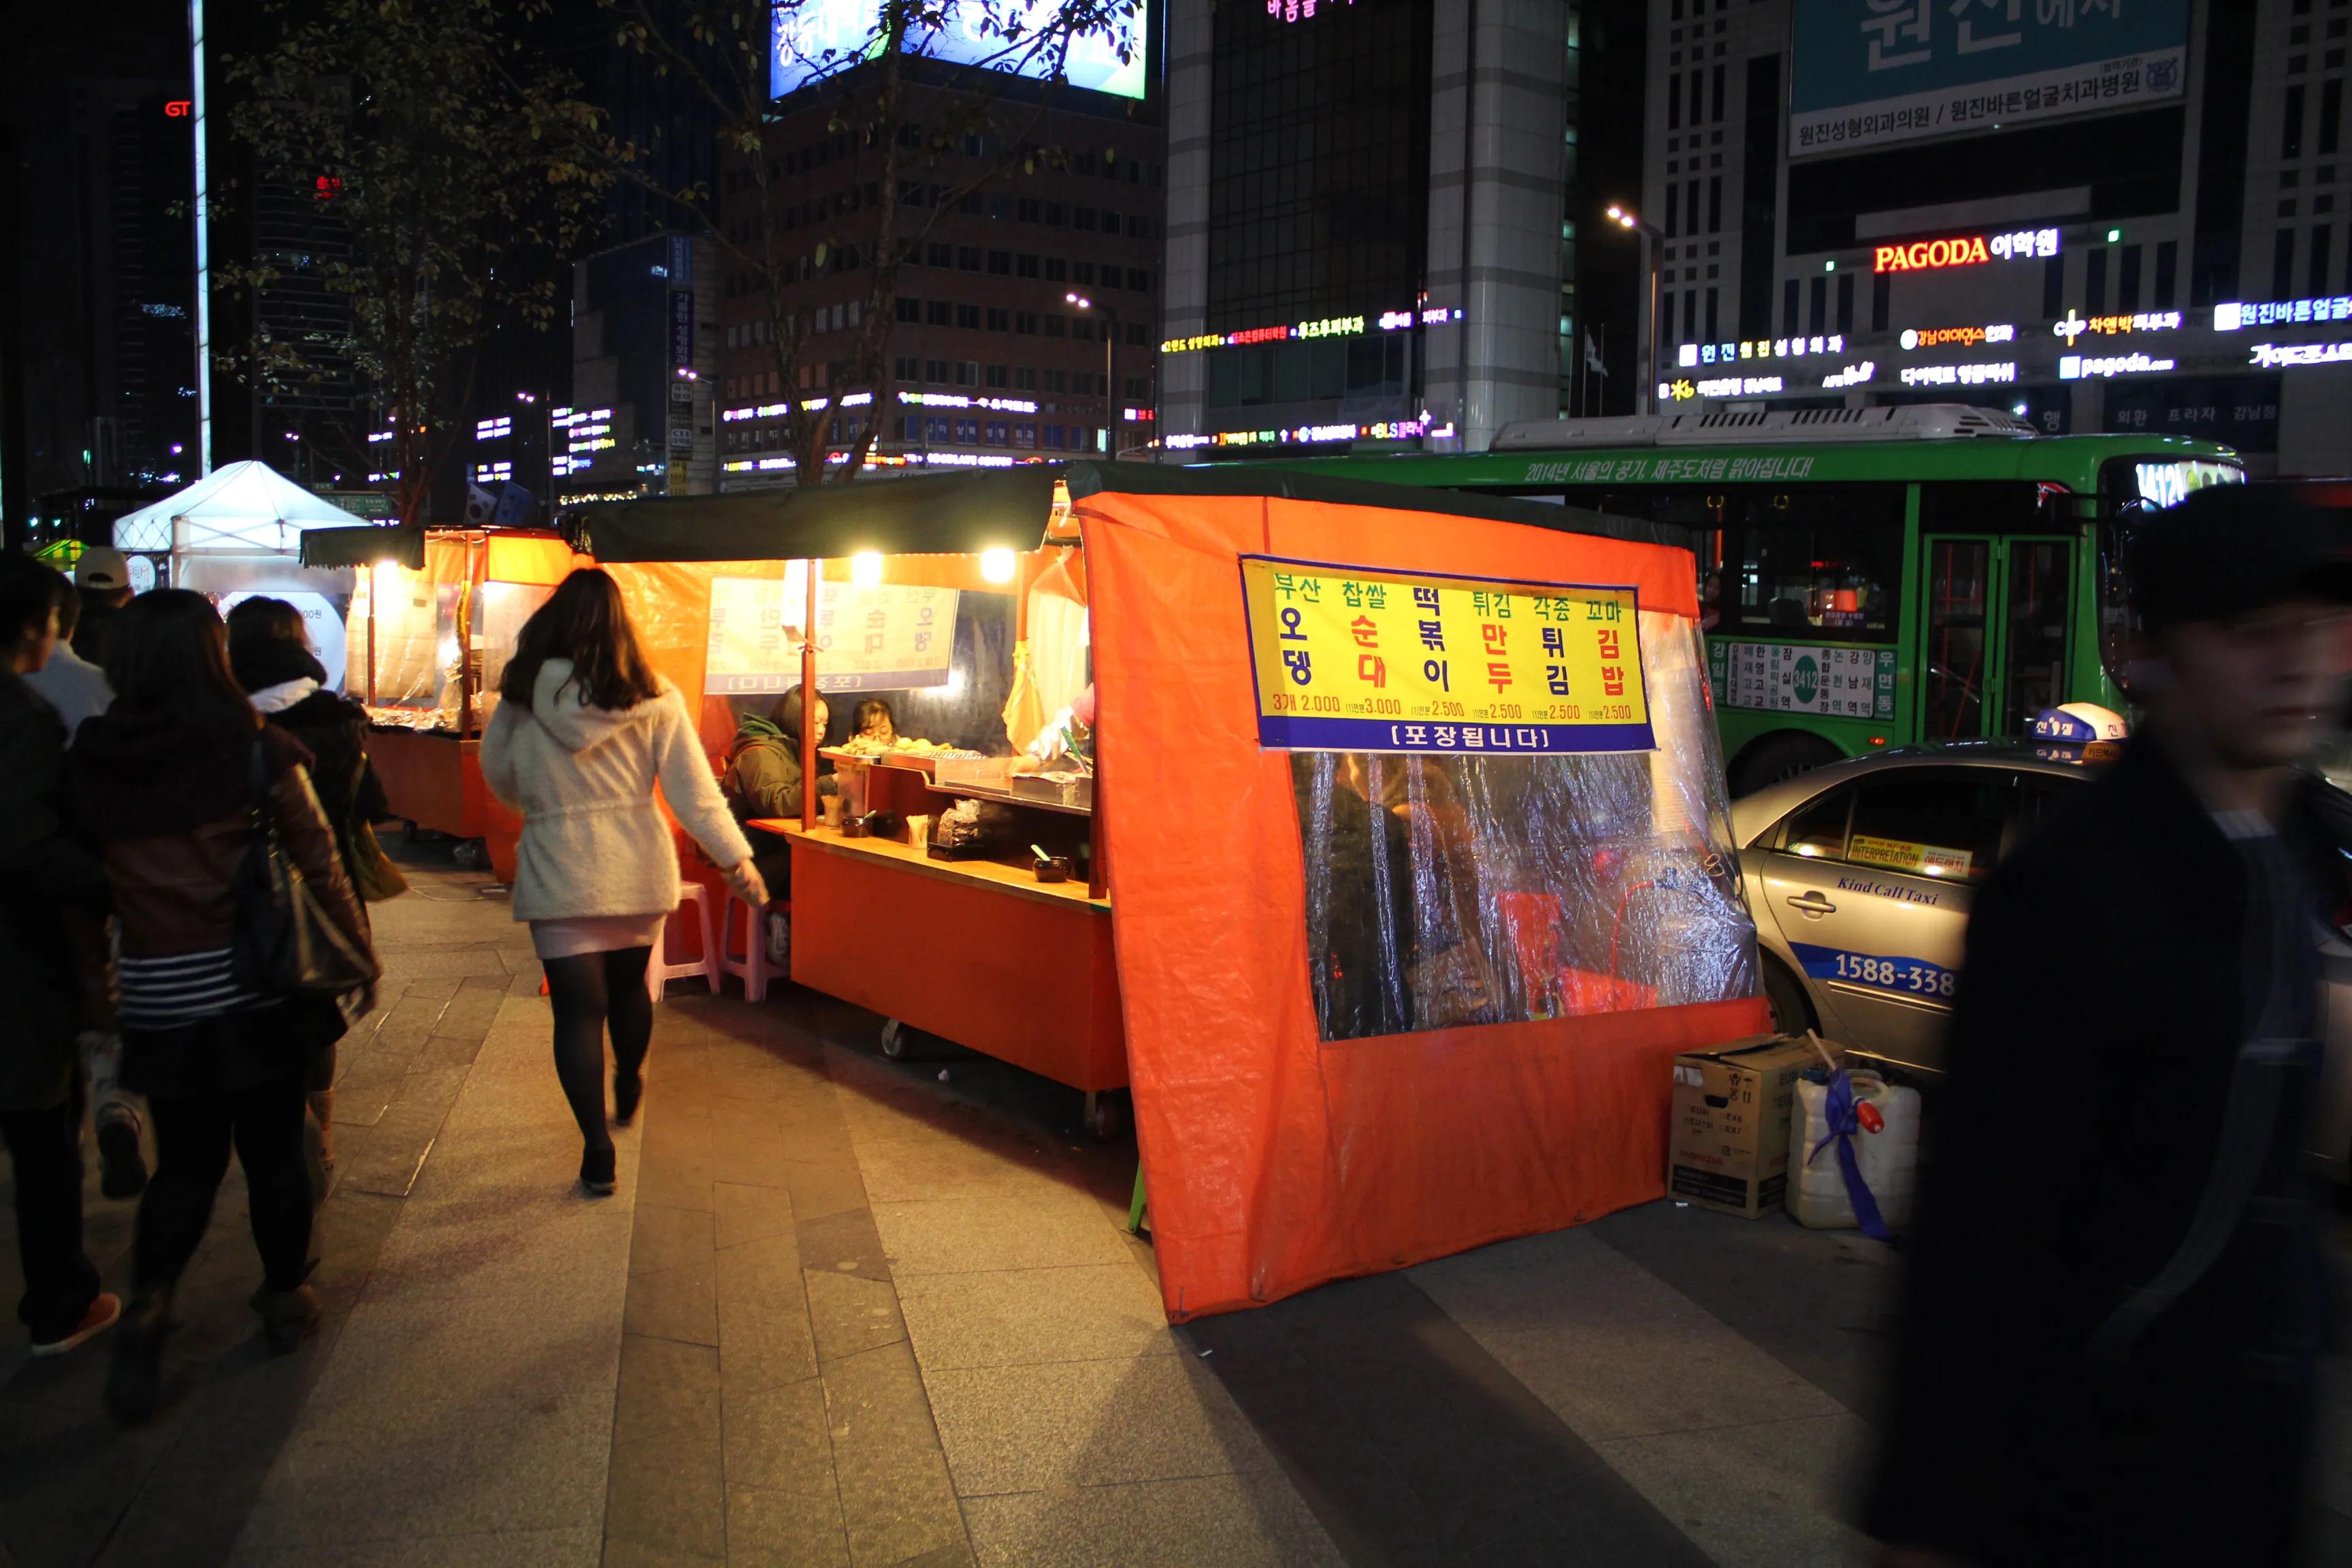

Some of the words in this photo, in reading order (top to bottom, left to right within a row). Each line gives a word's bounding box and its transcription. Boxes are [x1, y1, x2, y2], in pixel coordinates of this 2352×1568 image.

[1798, 105, 1931, 147] 원진성형외과의원
[1936, 103, 1944, 126] /
[1950, 71, 2142, 120] 원진바른얼굴치과병원
[1875, 237, 1990, 273] PAGODA
[2240, 298, 2352, 325] 원진바른얼굴
[2082, 353, 2174, 378] pagoda.com
[2117, 408, 2148, 426] 외환
[2168, 406, 2216, 422] 프라자
[2234, 405, 2276, 421] 강남점
[1524, 461, 1569, 483] 2014년
[1571, 460, 1616, 482] 서울의
[1616, 459, 1648, 481] 공기,
[1651, 457, 1728, 480] 제주도처럼
[1728, 457, 1815, 480] 맑아집니다!
[1275, 572, 1321, 603] 부산
[1342, 581, 1386, 609] 찹쌀
[301, 609, 321, 619] 00원
[1473, 591, 1511, 619] 튀김
[1533, 597, 1569, 621] 각종
[1586, 600, 1621, 623] 꼬마
[1280, 607, 1311, 685] 오뎅
[1351, 615, 1386, 688] 순대
[1414, 587, 1449, 691] 떡볶이
[1482, 623, 1512, 694] 만두
[1541, 627, 1569, 696] 튀김
[1597, 630, 1624, 696] 김밥
[1754, 645, 1765, 707] 한영고교
[1769, 646, 1780, 708] 올림픽공원
[1781, 647, 1793, 709] 잠실역
[1794, 670, 1818, 690] 3412
[1819, 648, 1831, 713] 종합운동장
[1832, 650, 1844, 713] 논현역
[1848, 651, 1860, 715] 강남역
[1861, 651, 1873, 716] 양재역
[1878, 651, 1895, 712] 우면동
[1273, 693, 1296, 711] 3개
[1302, 696, 1340, 712] 2.000
[1365, 698, 1401, 715] 3.000
[1432, 700, 1465, 717] 2.500
[1490, 704, 1522, 719] 2.500
[1550, 704, 1580, 720] 2.500
[1605, 705, 1631, 719] 2.500
[1391, 725, 1549, 748] (포장됩니다)
[1851, 845, 1918, 866] INTERPRETATION
[1838, 877, 1873, 895] Kind
[1874, 883, 1905, 900] Call
[1906, 887, 1938, 906] Taxi
[1835, 953, 1955, 996] 1588-338
[1726, 1113, 1742, 1124] EX6
[1726, 1126, 1742, 1134] EX7
